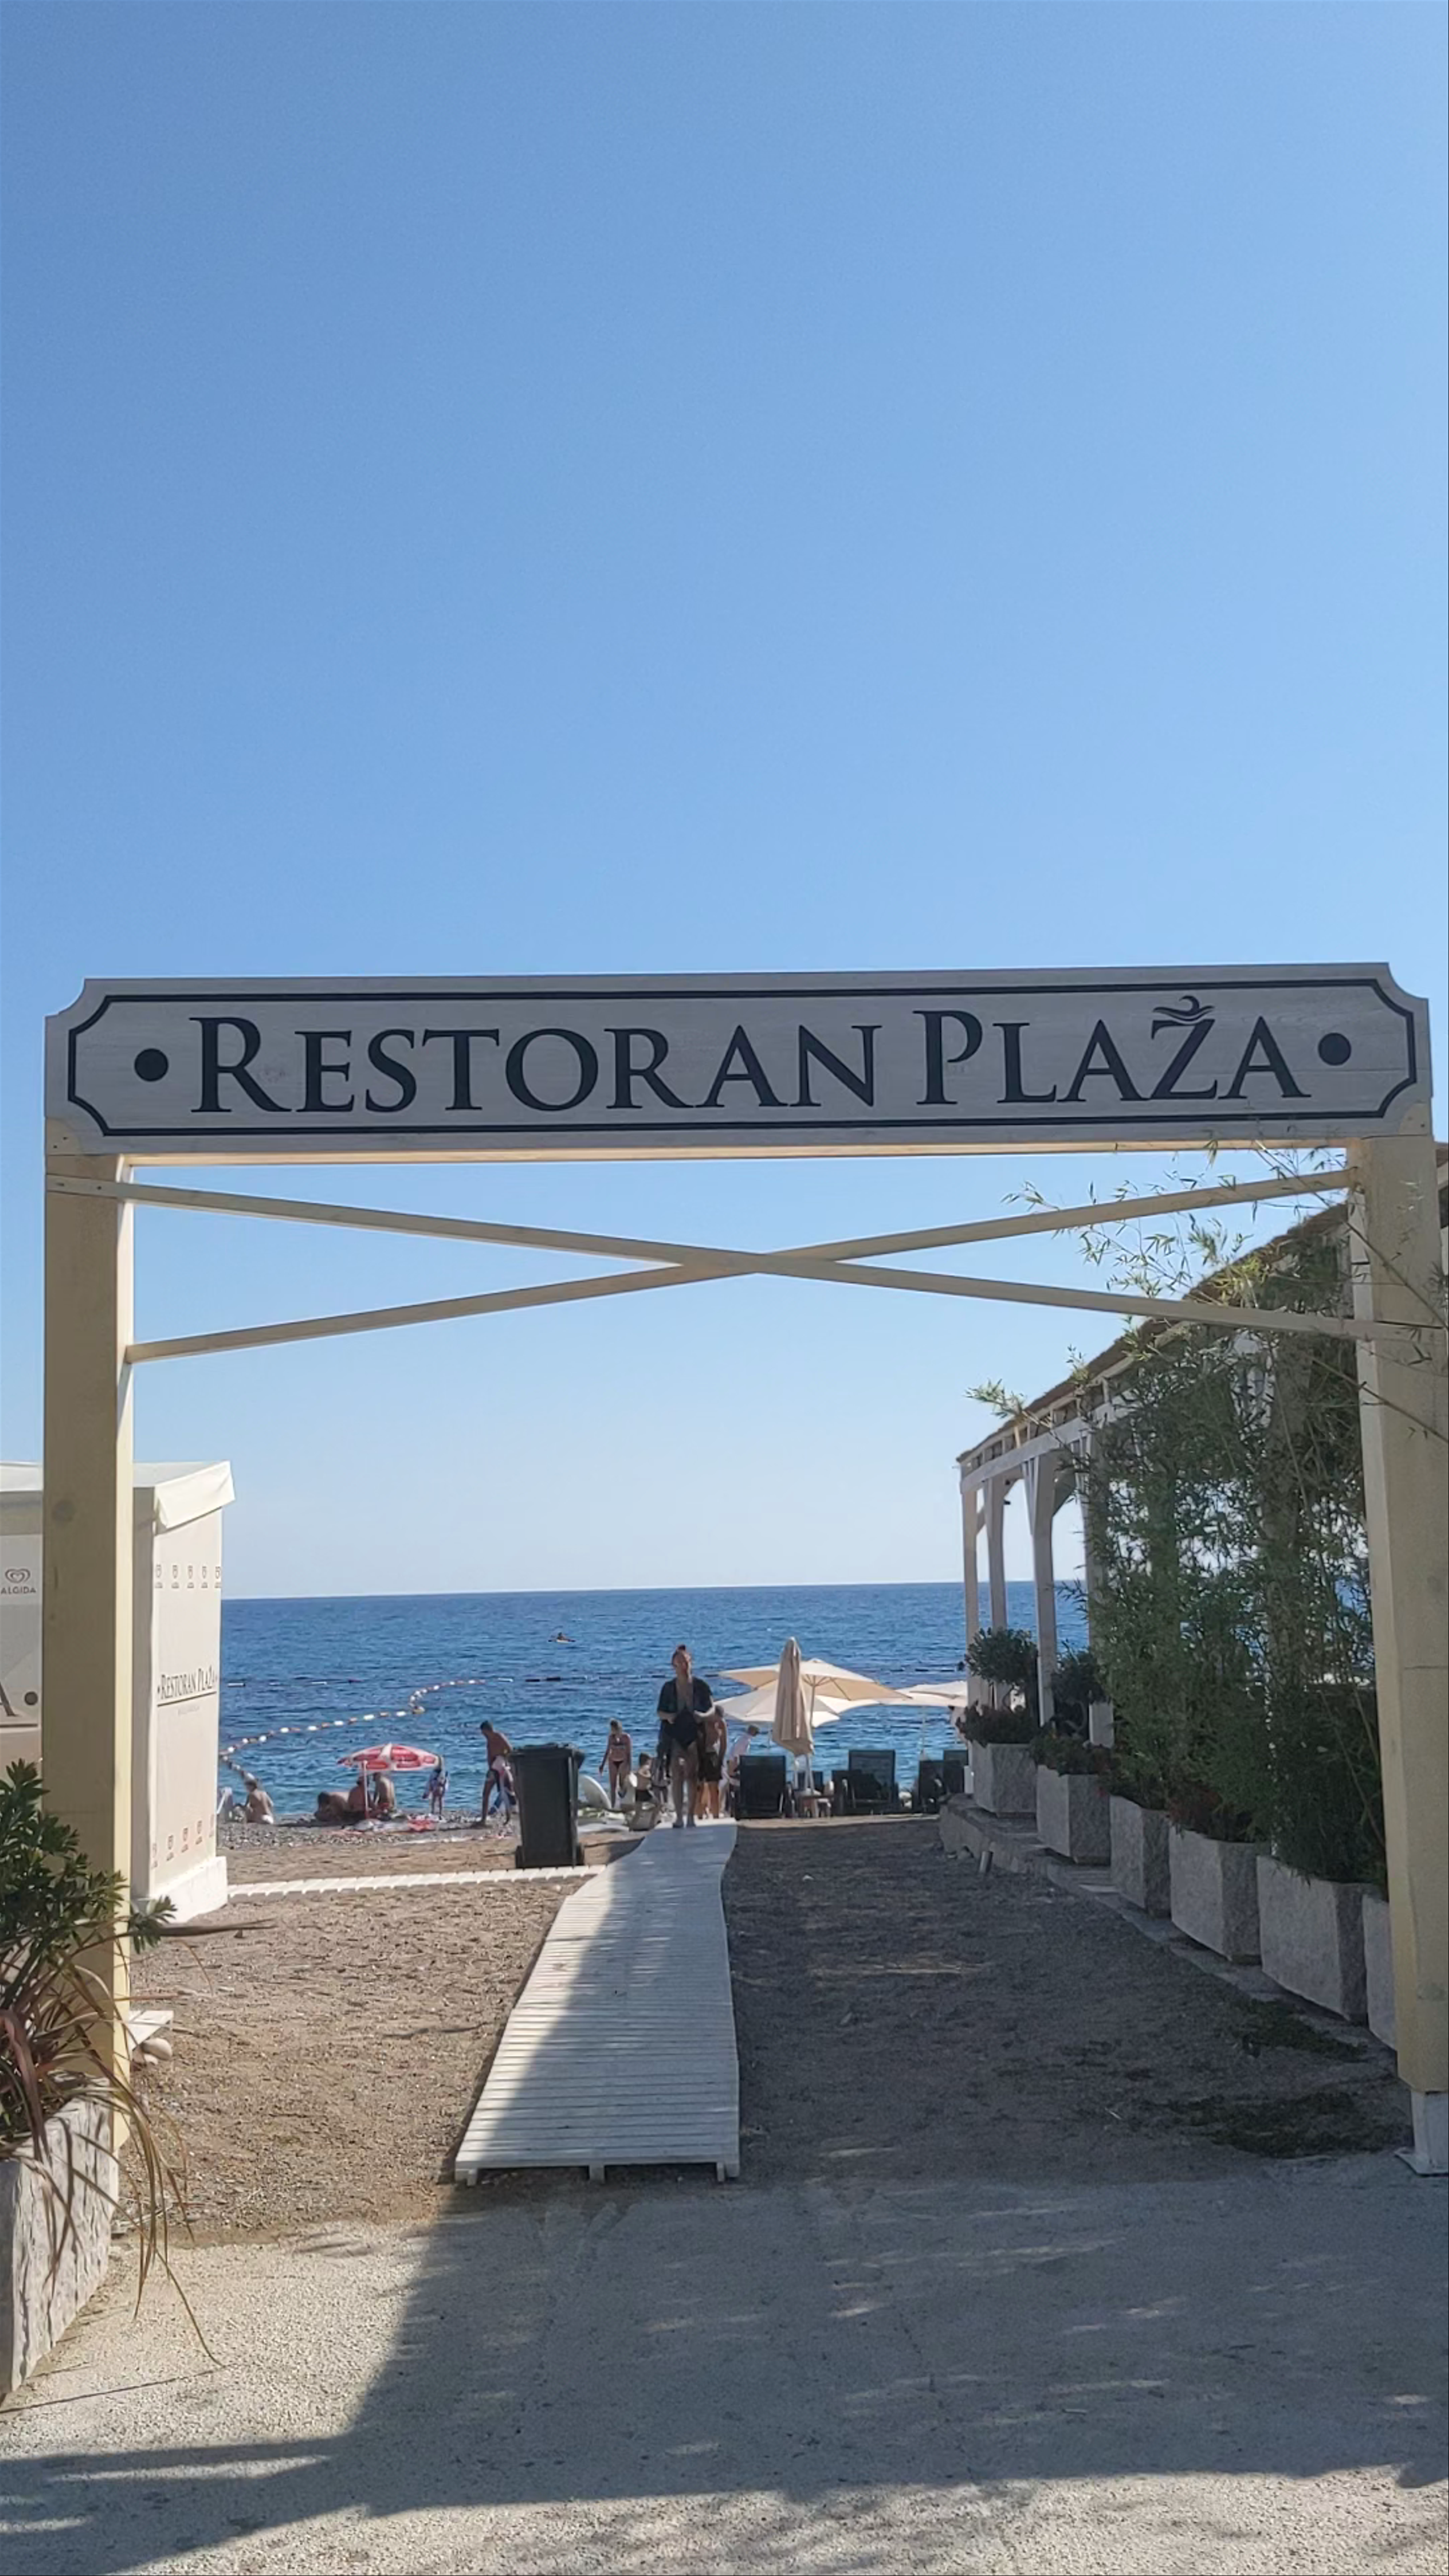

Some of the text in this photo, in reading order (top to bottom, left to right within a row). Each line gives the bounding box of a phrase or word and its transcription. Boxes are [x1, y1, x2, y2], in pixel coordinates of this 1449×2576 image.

[189, 995, 1312, 1113] RESTORAN PLAŽA
[1, 1586, 36, 1595] ALGIDA
